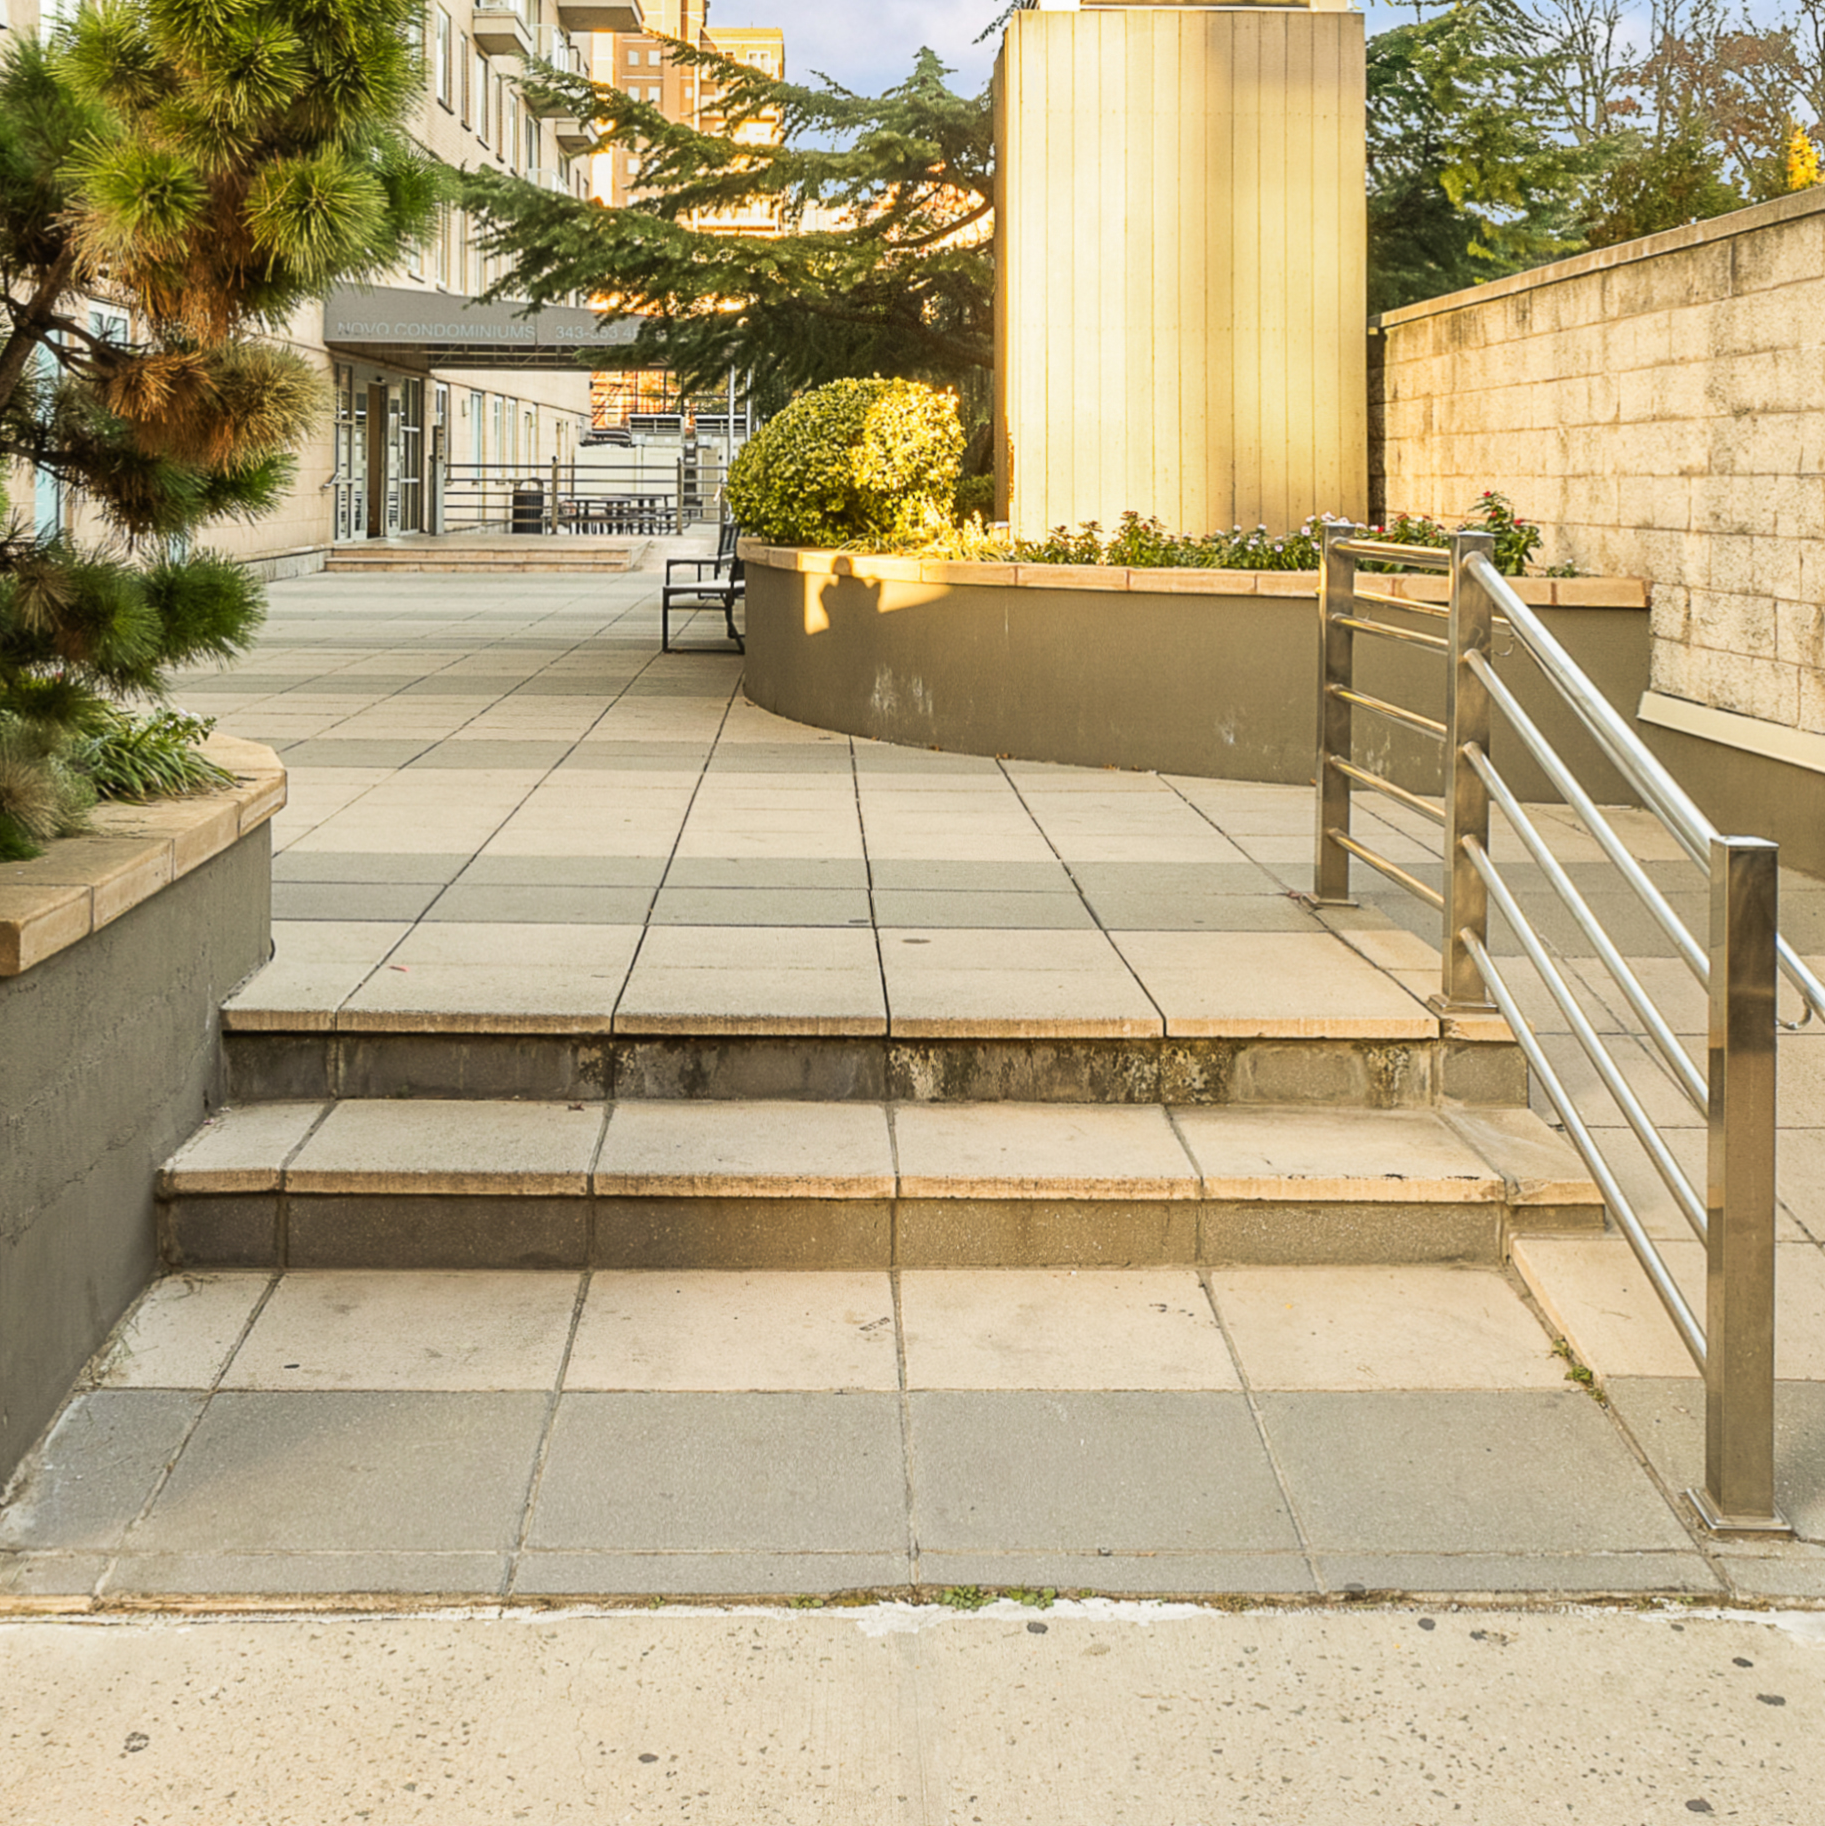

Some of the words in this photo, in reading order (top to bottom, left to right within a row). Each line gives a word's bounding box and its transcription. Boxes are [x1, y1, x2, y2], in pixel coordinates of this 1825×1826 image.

[337, 321, 390, 336] NOVO
[394, 322, 536, 339] CONDOMINIUMS
[555, 325, 618, 340] 343-353
